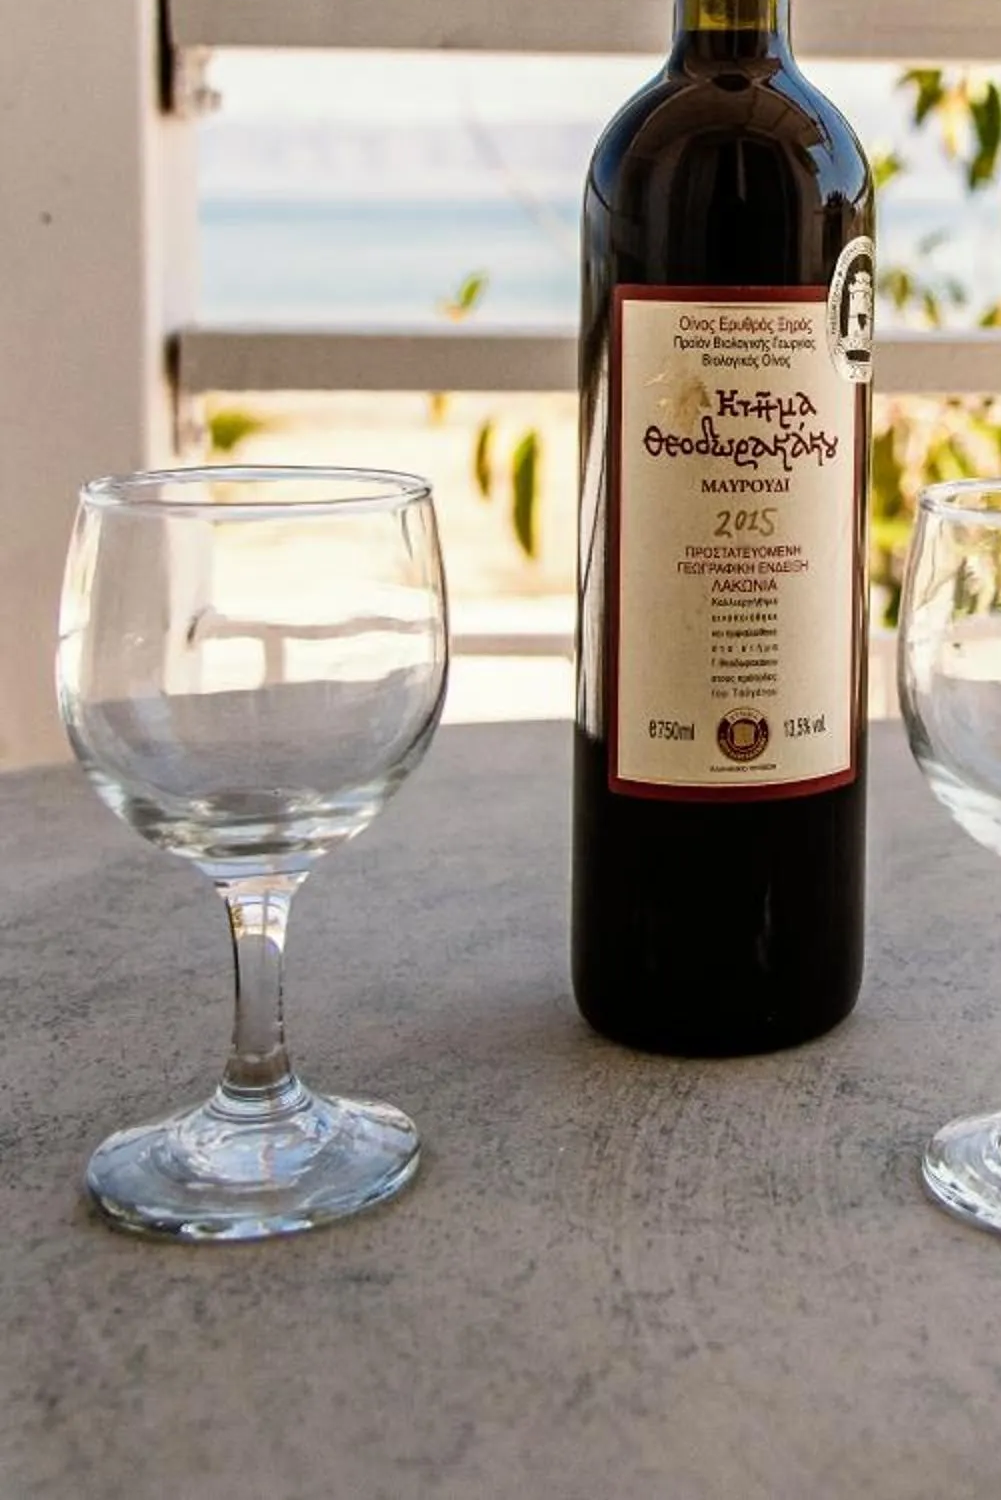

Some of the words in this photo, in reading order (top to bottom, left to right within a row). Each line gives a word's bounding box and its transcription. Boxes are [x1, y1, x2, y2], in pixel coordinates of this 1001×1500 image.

[701, 478, 790, 493] ΜΑΥΡΟΥΔΙ
[713, 508, 778, 538] 2015
[685, 545, 802, 559] ΠΡΟΣΤΑΤΕΥΟΜΕΝΗ
[711, 578, 778, 593] ΛΑΚΩΝΙΑ
